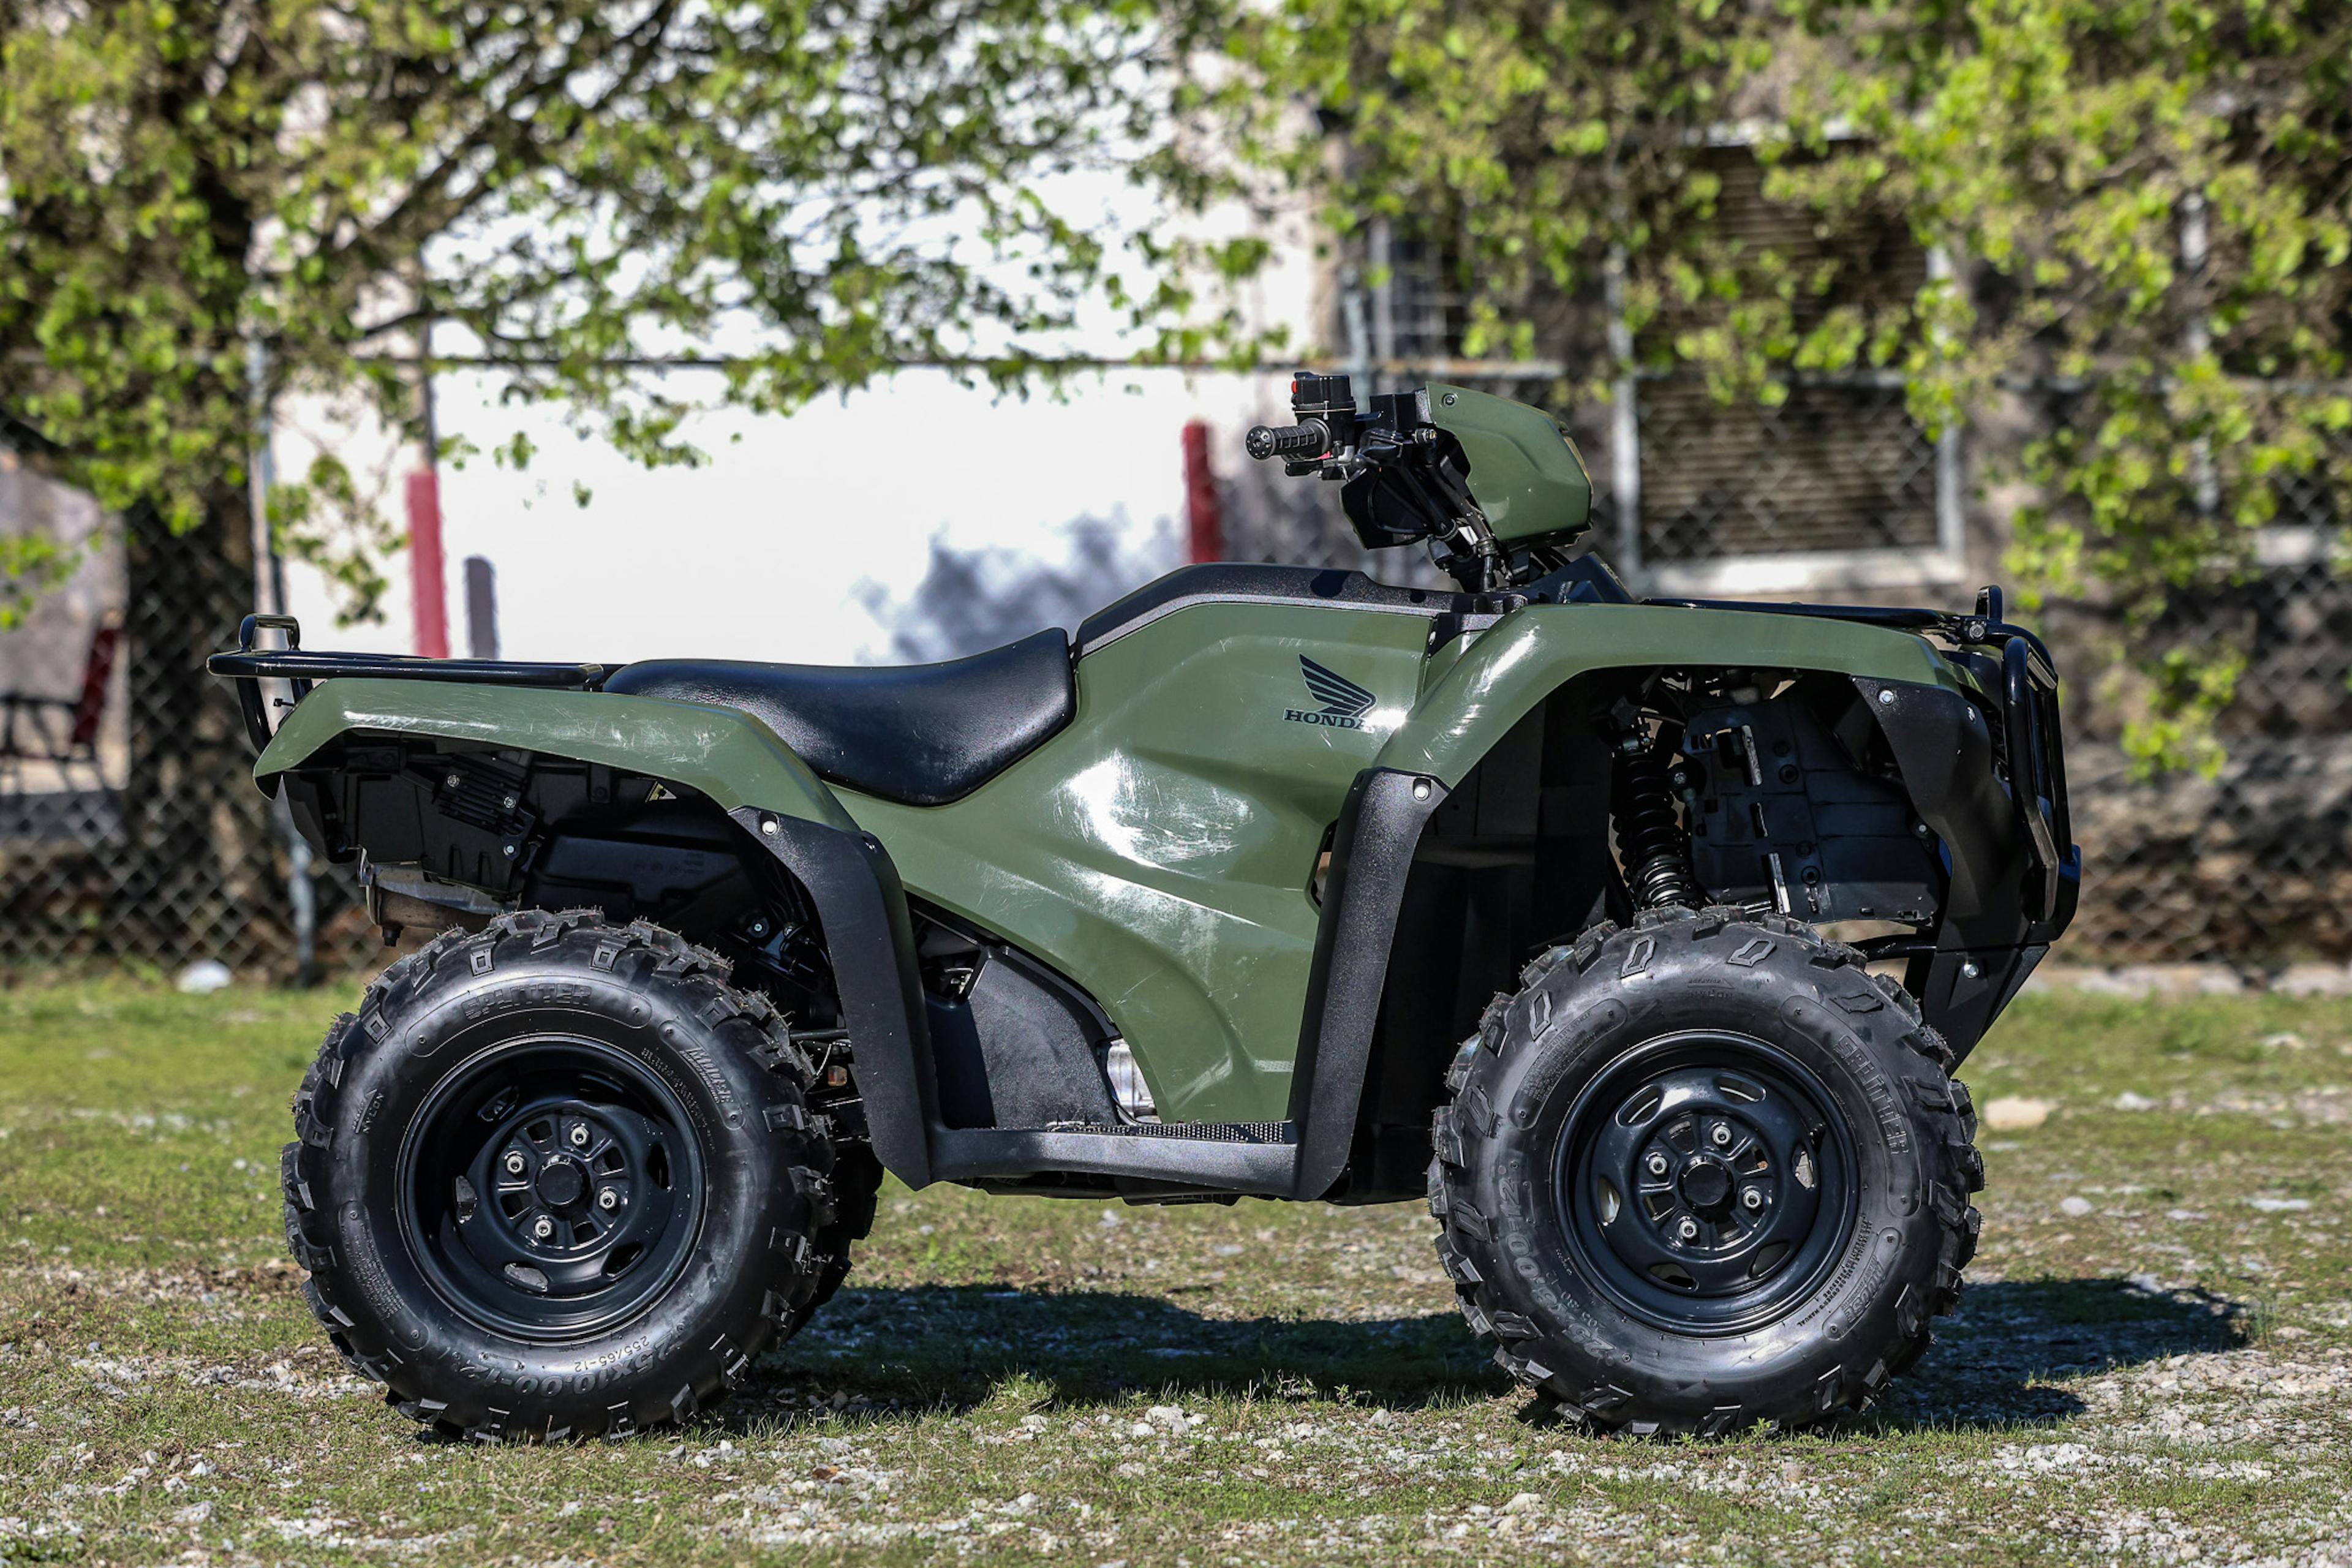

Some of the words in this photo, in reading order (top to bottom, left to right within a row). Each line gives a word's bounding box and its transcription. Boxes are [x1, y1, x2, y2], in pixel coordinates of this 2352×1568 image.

[460, 983, 593, 1020] SPLITTER
[362, 1093, 384, 1134] NYLON
[1832, 1033, 1909, 1156] SPLITTER
[1823, 1267, 1848, 1298] PRESSURE
[1842, 1260, 1885, 1324] MOOSE
[1796, 1308, 1820, 1328] MANUAL
[573, 1335, 650, 1373] 255/65-12
